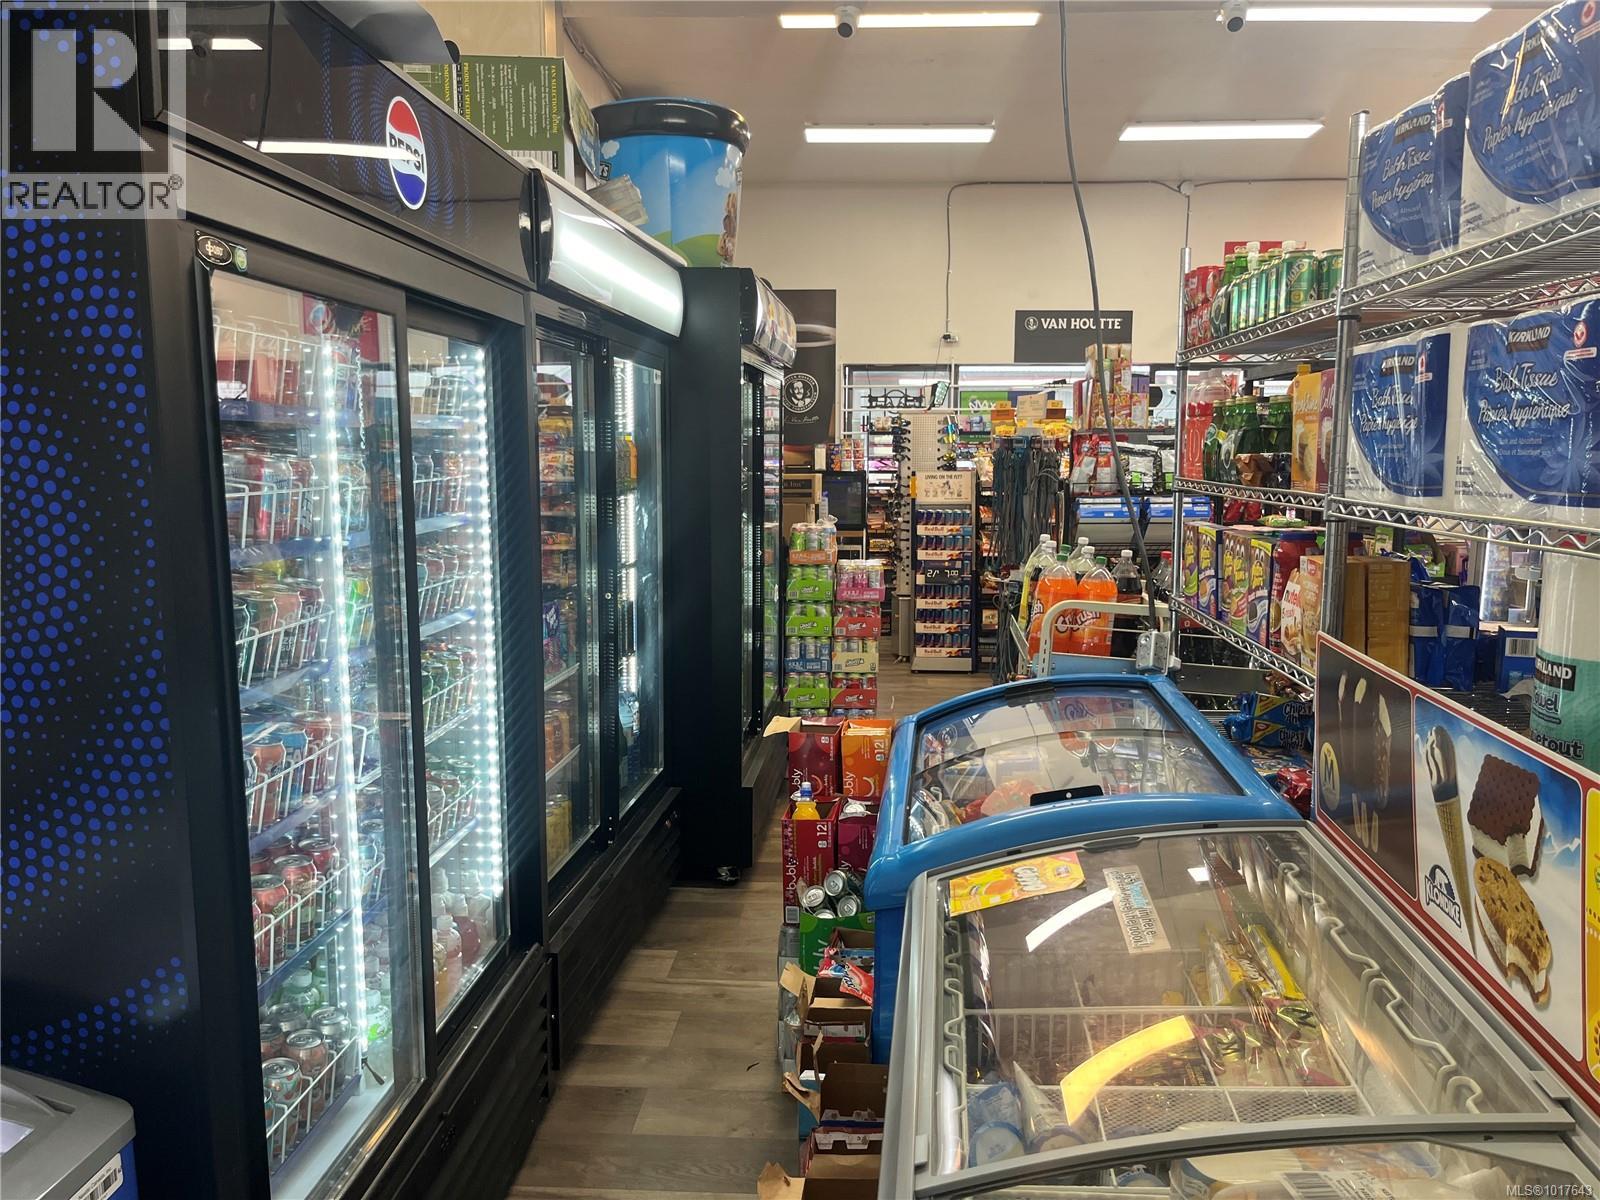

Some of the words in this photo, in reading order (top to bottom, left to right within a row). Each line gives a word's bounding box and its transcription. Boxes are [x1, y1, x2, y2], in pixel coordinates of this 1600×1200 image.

[1482, 124, 1512, 153] Papier
[1382, 151, 1407, 181] Bath
[1041, 318, 1067, 330] VAN
[1071, 317, 1122, 330] HOUTTE
[1508, 326, 1551, 343] KIRKLAND
[1495, 368, 1518, 393] Bath
[1518, 363, 1558, 388] Tissue
[1372, 386, 1391, 408] Bath
[1478, 401, 1509, 424] Papier
[874, 741, 885, 754] 12
[816, 823, 828, 837] 12
[1425, 876, 1461, 923] KLONDIKE
